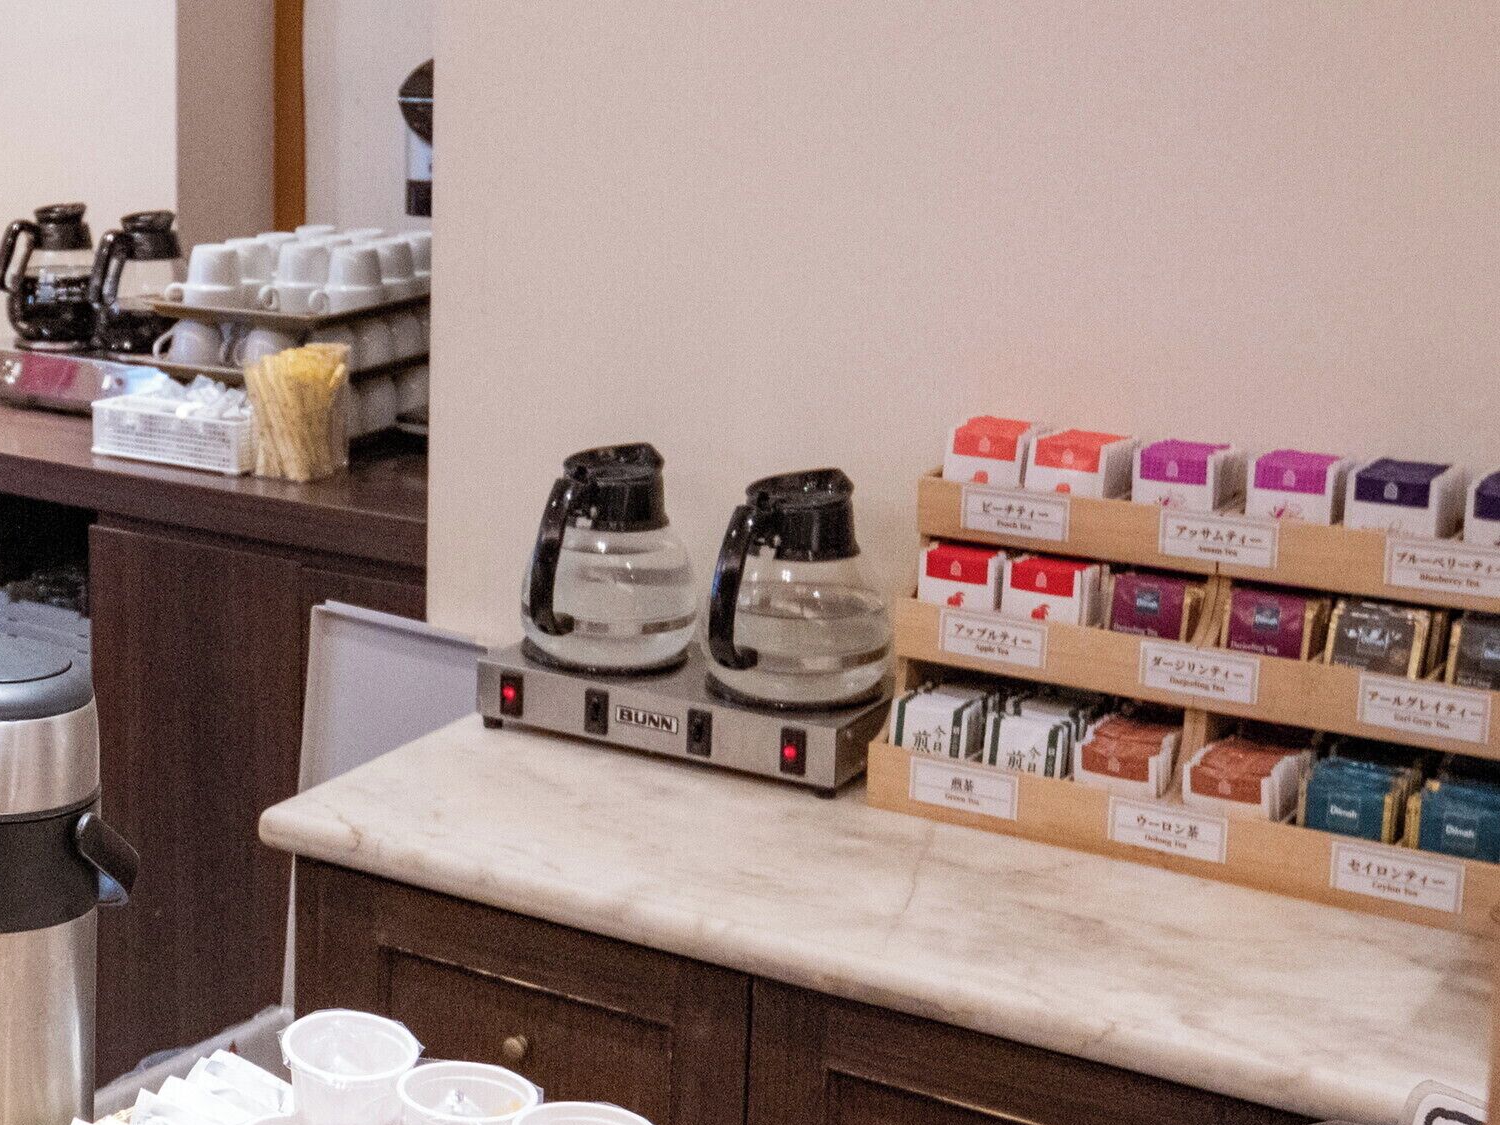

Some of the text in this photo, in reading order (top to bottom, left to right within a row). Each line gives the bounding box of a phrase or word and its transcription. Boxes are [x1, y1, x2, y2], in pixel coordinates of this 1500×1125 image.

[1175, 525, 1262, 546] アッサムティー
[954, 623, 1032, 647] アップルティー
[1152, 656, 1244, 681] ダージリンティー
[1368, 690, 1482, 718] アールグレイティー
[618, 707, 676, 731] BUNN
[1136, 814, 1199, 840] ウーロン茶
[1349, 859, 1445, 886] セイロンティー
